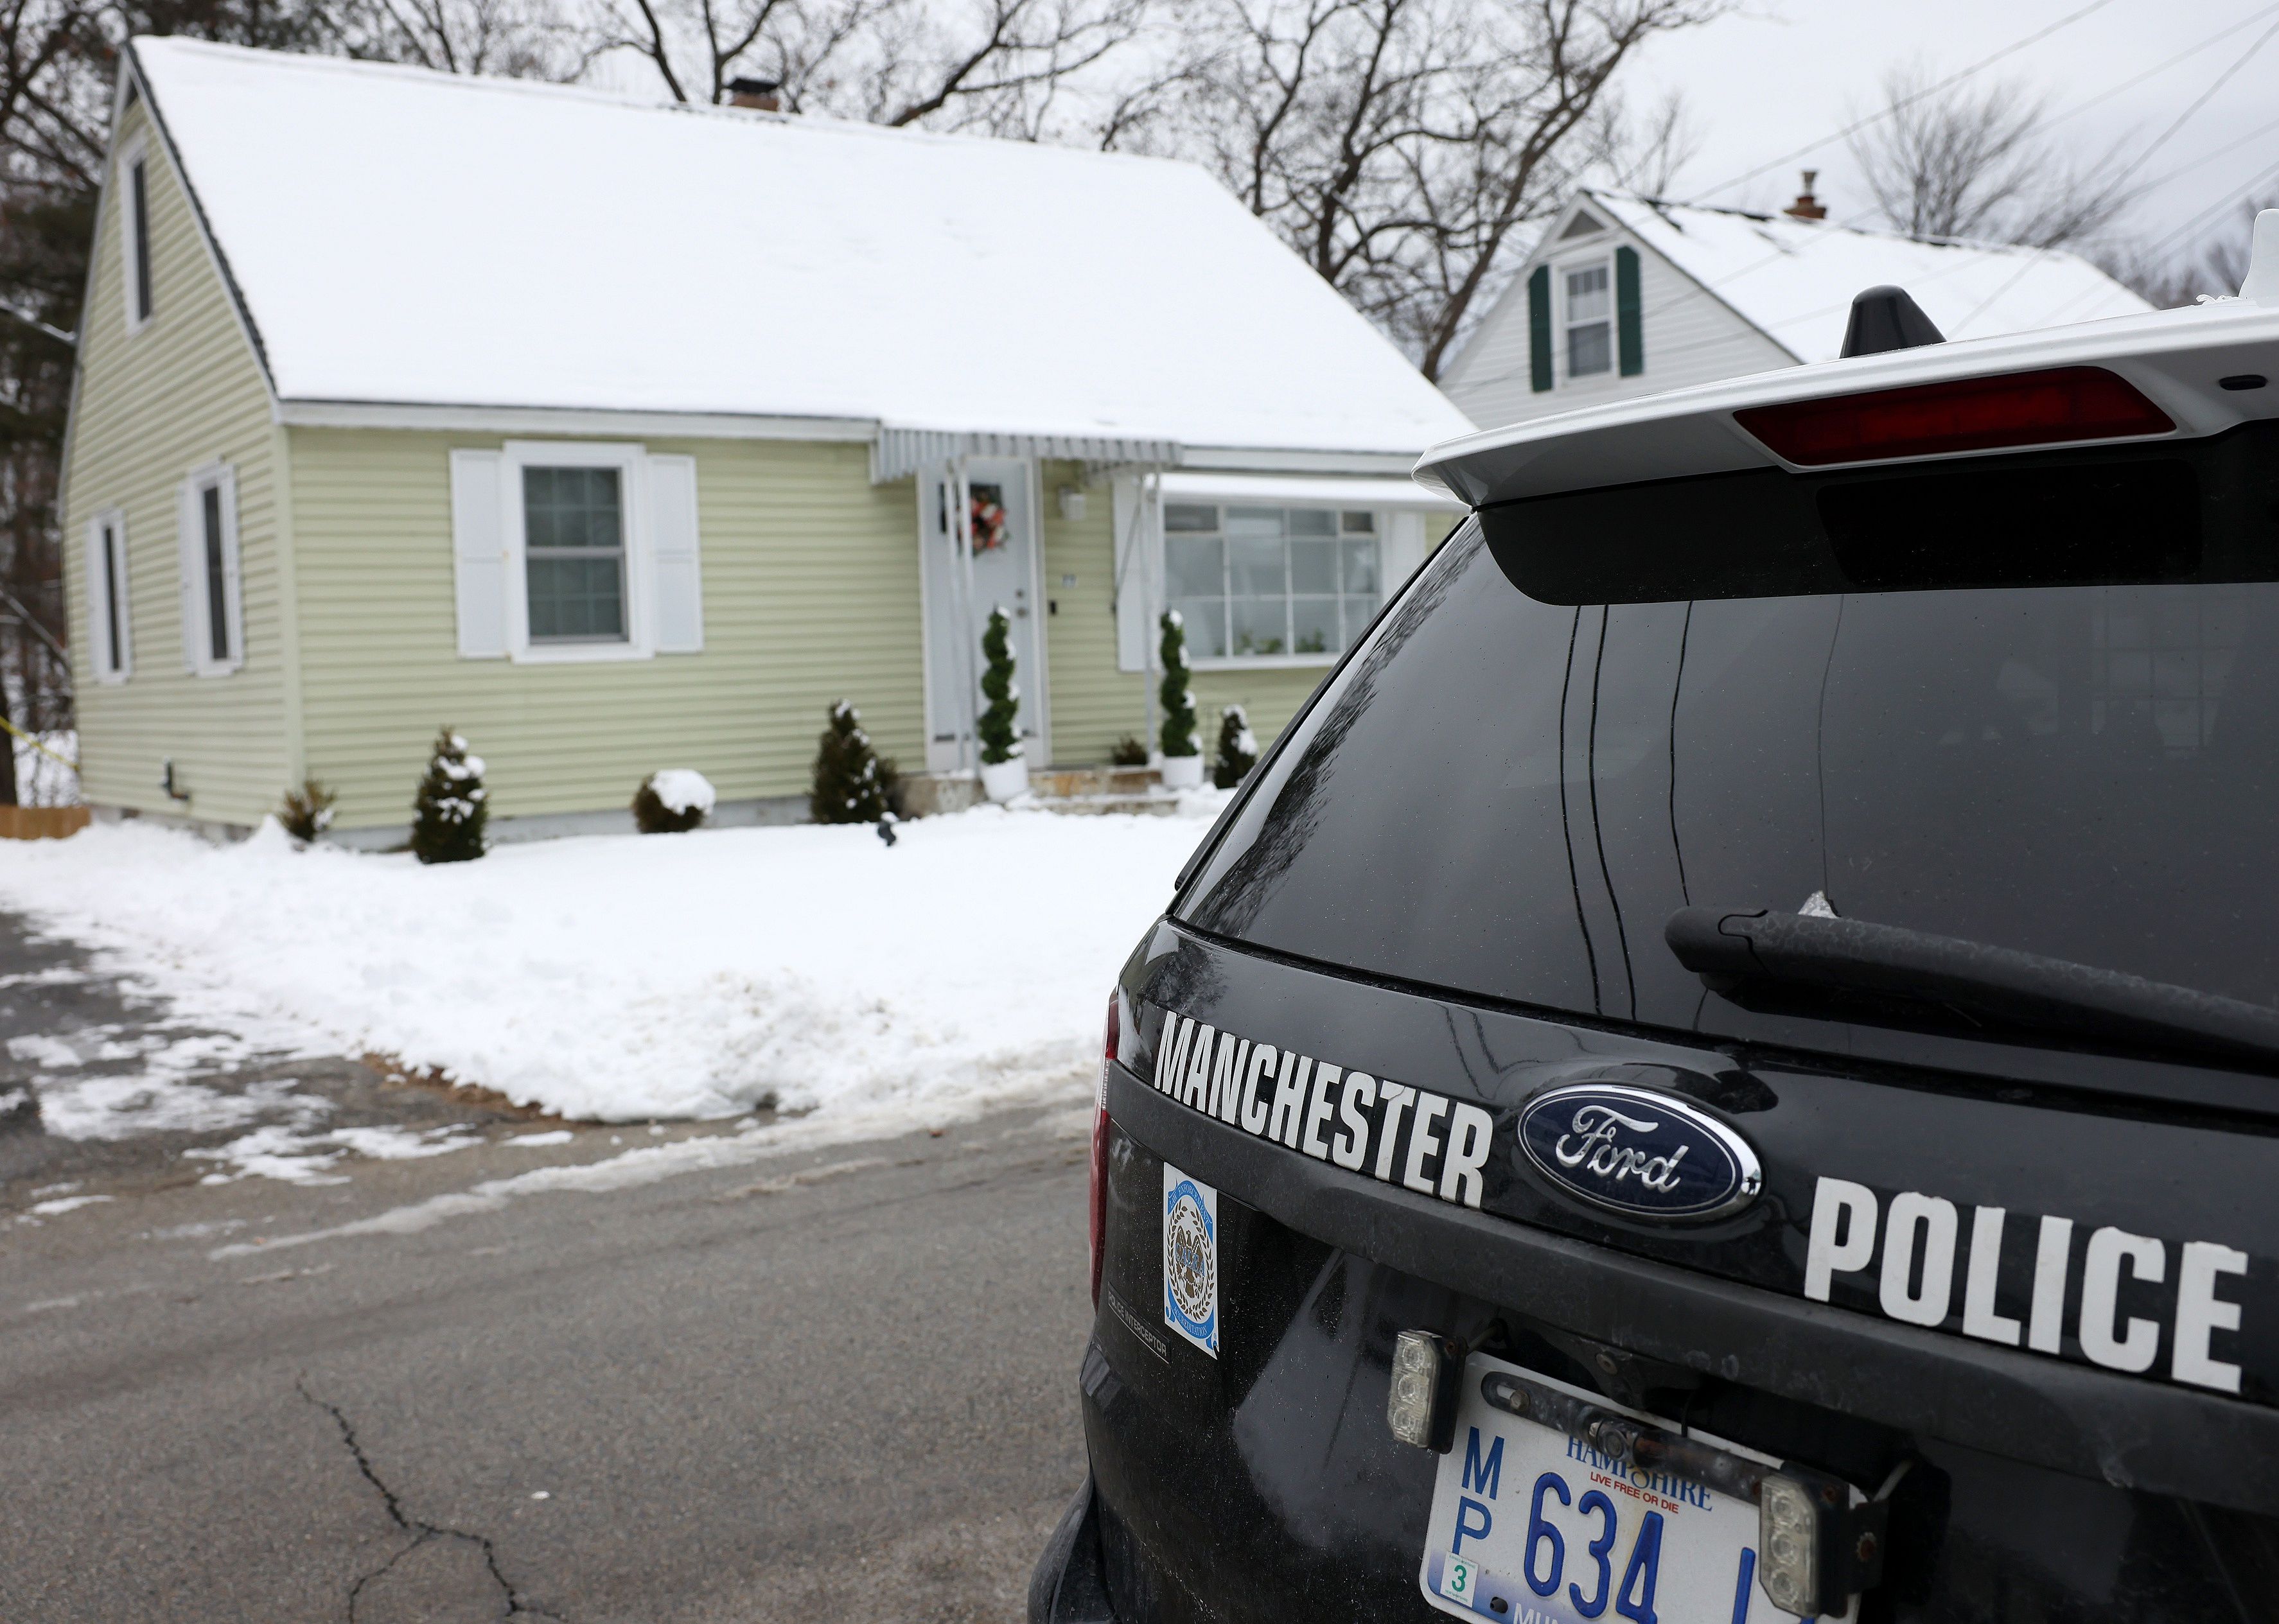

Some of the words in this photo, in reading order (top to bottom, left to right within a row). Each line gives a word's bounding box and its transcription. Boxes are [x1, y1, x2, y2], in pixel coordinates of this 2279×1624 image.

[1154, 1011, 1493, 1209] MANCHESTER
[1555, 1104, 1689, 1193] Ford
[1175, 1242, 1205, 1277] CALEA
[1804, 1176, 2248, 1393] POLICE
[1124, 1309, 1167, 1357] INTERCEPTOR
[1173, 1306, 1208, 1336] ACCREDITATION
[1590, 1471, 1612, 1487] LIVE
[1614, 1481, 1641, 1499] FREE
[1642, 1492, 1659, 1506] OR
[1660, 1499, 1680, 1514] DIE
[1452, 1564, 1466, 1592] 3
